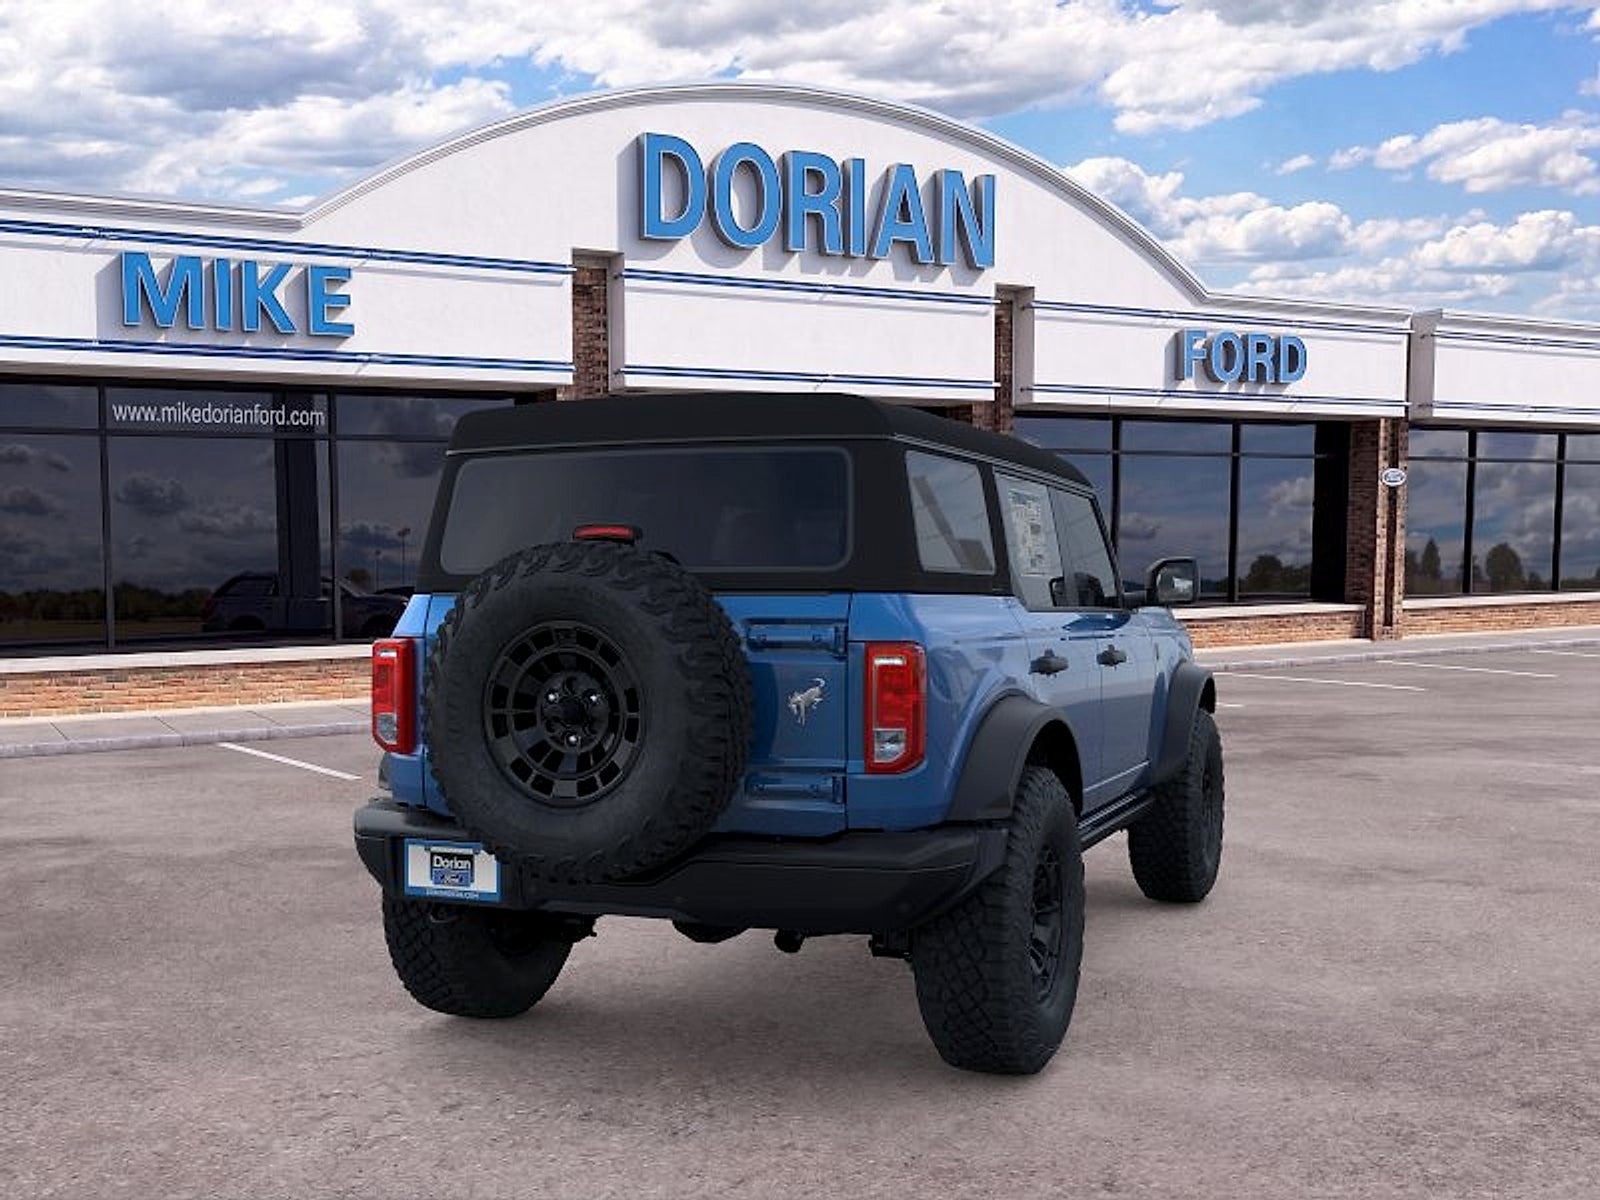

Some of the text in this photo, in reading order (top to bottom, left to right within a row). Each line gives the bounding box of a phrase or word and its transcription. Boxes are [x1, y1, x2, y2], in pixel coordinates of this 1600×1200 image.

[639, 132, 996, 270] DORIAN
[122, 251, 355, 337] MIKE
[1177, 328, 1308, 384] FORD
[112, 402, 326, 426] www.mikedorianford.com
[433, 855, 471, 869] Dorian
